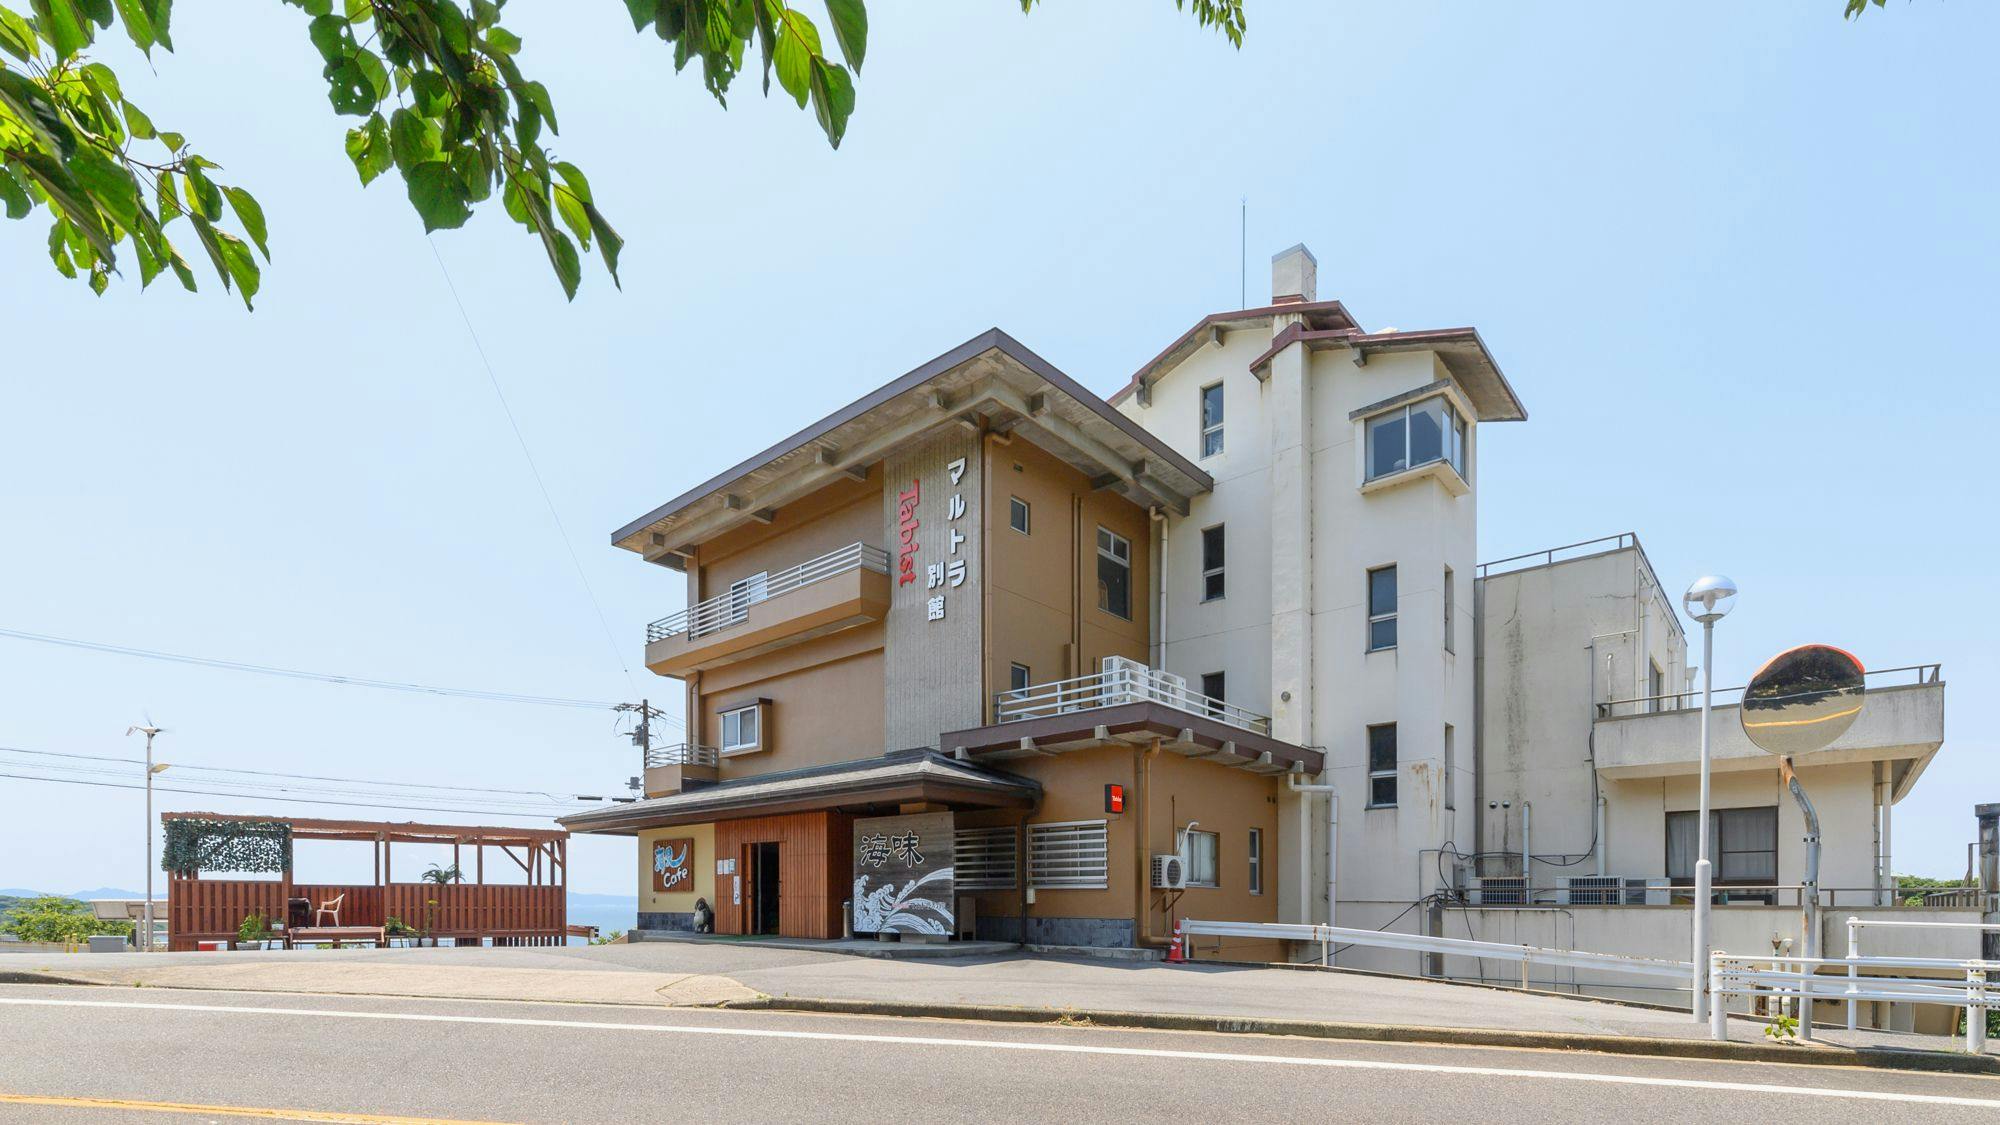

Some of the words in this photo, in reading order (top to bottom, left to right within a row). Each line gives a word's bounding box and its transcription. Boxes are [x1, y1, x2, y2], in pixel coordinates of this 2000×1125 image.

[899, 479, 920, 588] Tabist
[947, 457, 967, 589] マルトラ
[927, 561, 946, 622] 別館
[663, 867, 688, 888] Cafe
[860, 830, 924, 868] 海味
